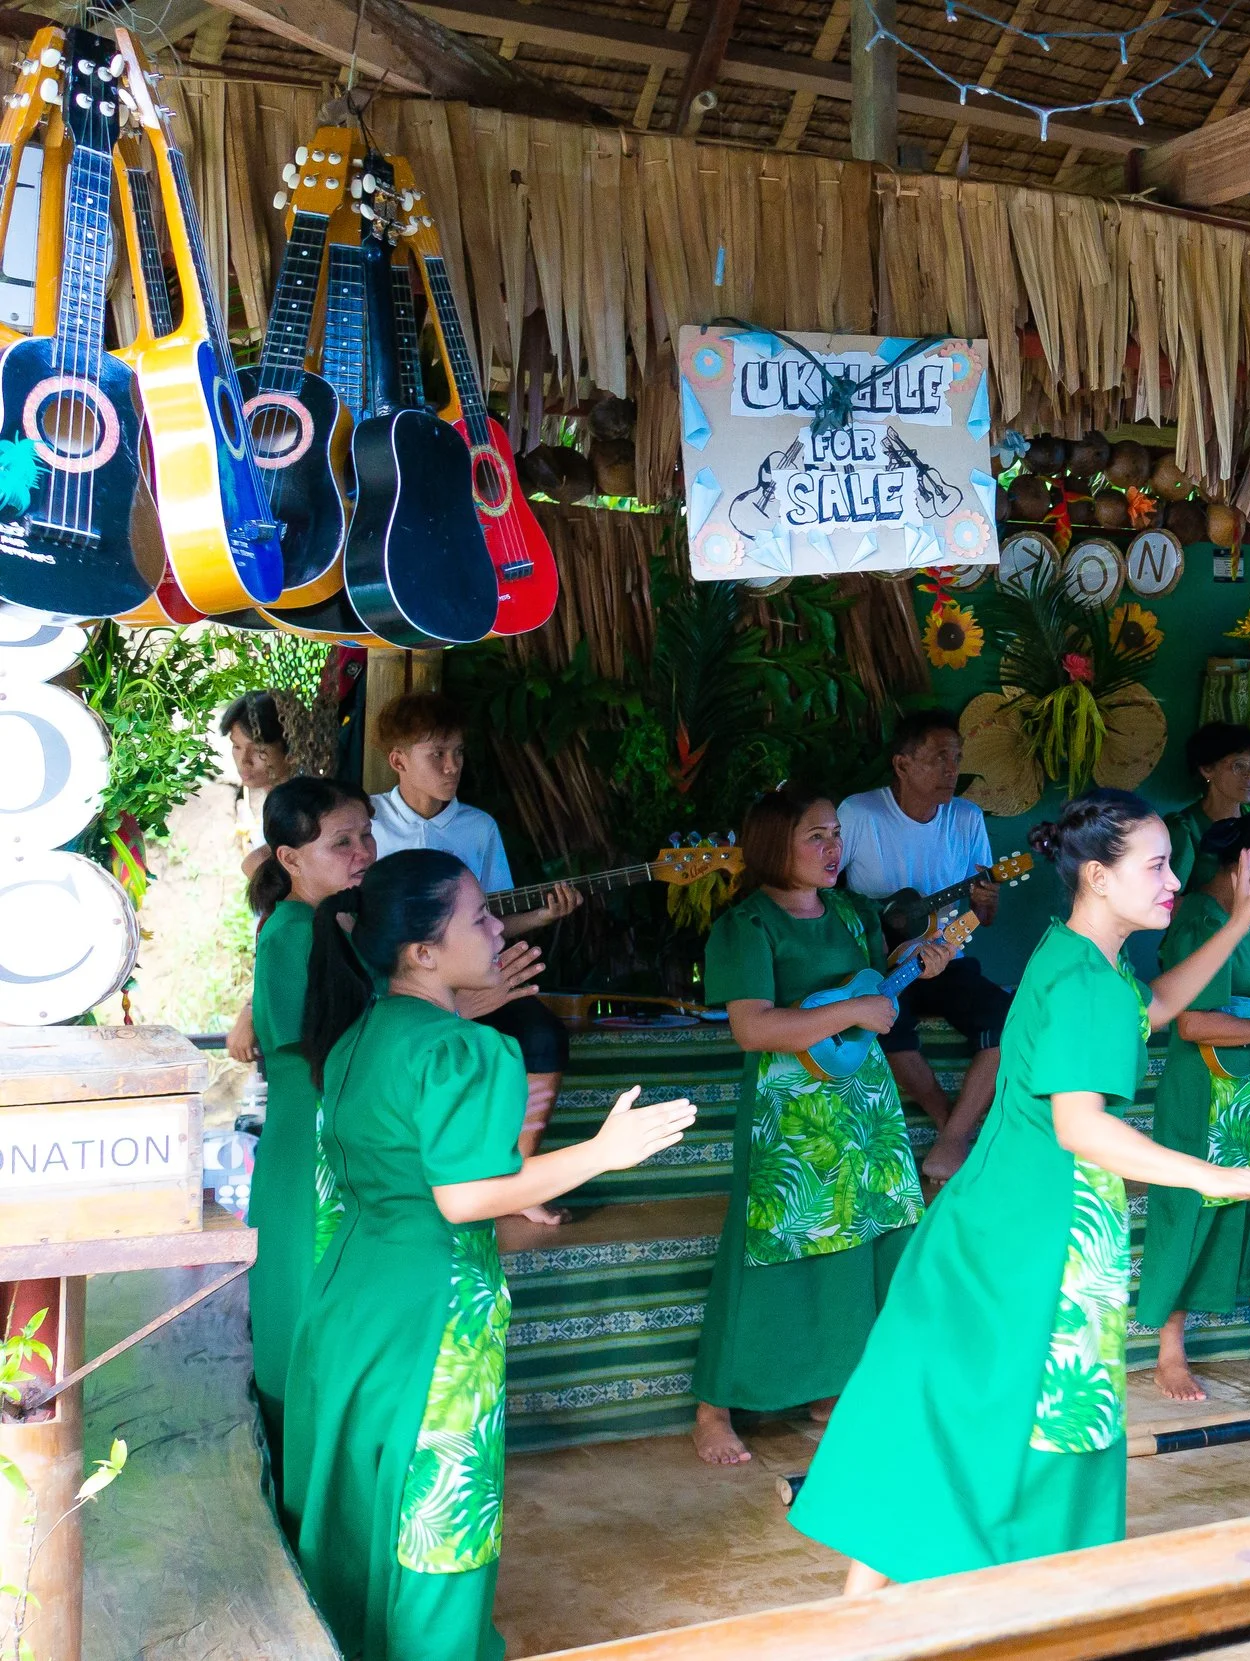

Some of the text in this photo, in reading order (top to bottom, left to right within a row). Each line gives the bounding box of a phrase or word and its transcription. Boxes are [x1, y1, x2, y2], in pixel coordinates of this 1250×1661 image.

[811, 428, 877, 462] FOR
[785, 471, 906, 526] SALE
[0, 1134, 170, 1174] NATION
